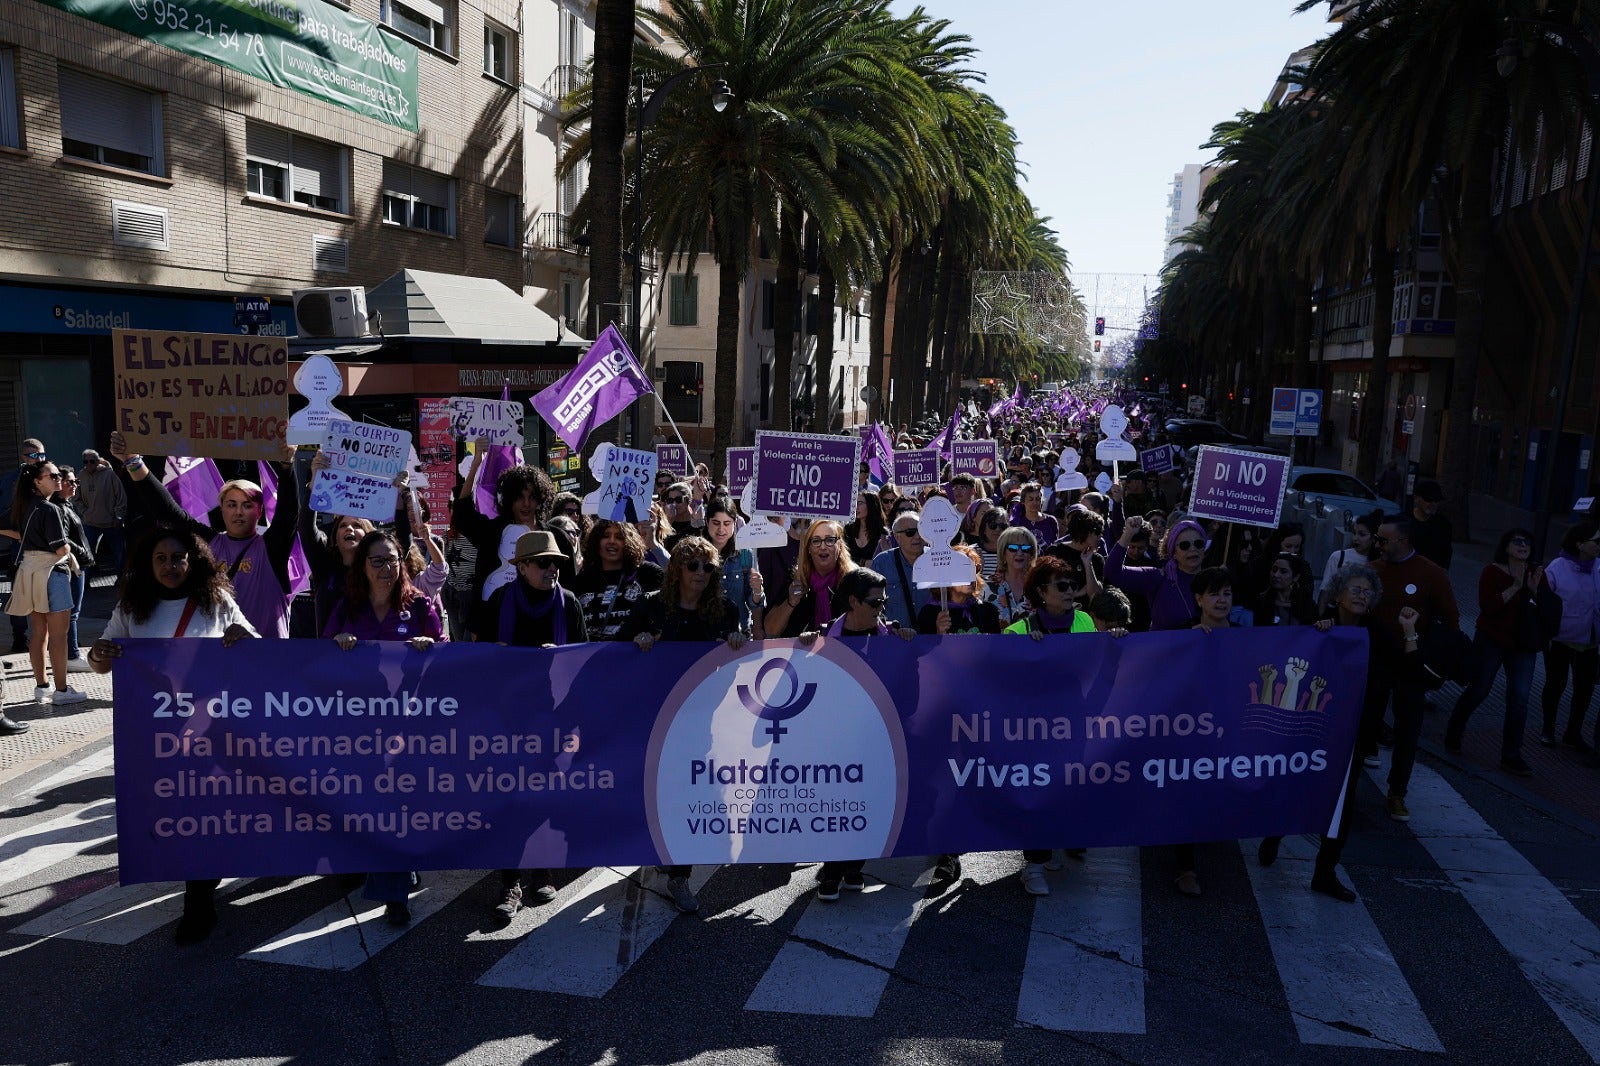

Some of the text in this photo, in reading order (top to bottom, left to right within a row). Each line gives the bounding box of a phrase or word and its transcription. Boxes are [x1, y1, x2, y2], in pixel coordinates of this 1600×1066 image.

[153, 0, 264, 57] 952 21 54 76
[298, 12, 329, 43] para
[332, 23, 407, 73] trabajadores
[287, 54, 397, 107] www.academiaintegral.es
[246, 302, 269, 311] ATM
[64, 308, 130, 329] Sabadell
[240, 320, 286, 337] Sadell
[123, 335, 166, 369] EL
[161, 378, 182, 397] ES
[454, 400, 475, 413] ES
[1298, 391, 1319, 416] P
[121, 408, 150, 435] ES
[331, 420, 400, 443] MI CUERPO
[455, 414, 510, 443] Cuerpo
[340, 438, 360, 453] NO
[662, 448, 680, 459] DI NO
[791, 440, 823, 450] Ante la
[955, 445, 993, 454] EL MACHISMO
[1155, 449, 1166, 460] NO
[608, 448, 619, 462] SI
[622, 452, 652, 466] DUELE
[738, 457, 748, 471] DI
[763, 450, 851, 464] Violencia de Género
[956, 457, 977, 469] MATA
[320, 471, 338, 480] NO
[609, 464, 650, 485] NO ES
[789, 463, 822, 487] ¡NO
[900, 473, 933, 483] TE CALLES!
[1214, 460, 1267, 487] DI NO
[602, 481, 646, 503] AMOR
[769, 488, 841, 510] TE CALLES!
[1207, 487, 1266, 503] A la Violencia
[1196, 498, 1274, 516] contra las mujeres
[152, 689, 459, 719] 25 de Noviembre
[951, 710, 1225, 743] Ni una menos,
[154, 727, 581, 760] Día Internacional para la
[691, 758, 864, 785] Plataforma
[947, 748, 1328, 788] Vivas nos queremos
[154, 763, 615, 798] eliminación de la violencia
[734, 785, 816, 799] contra las
[688, 799, 866, 814] violencias machistas
[154, 805, 492, 838] contra las mujeres.
[687, 815, 868, 835] VIOLENCIA CERO
